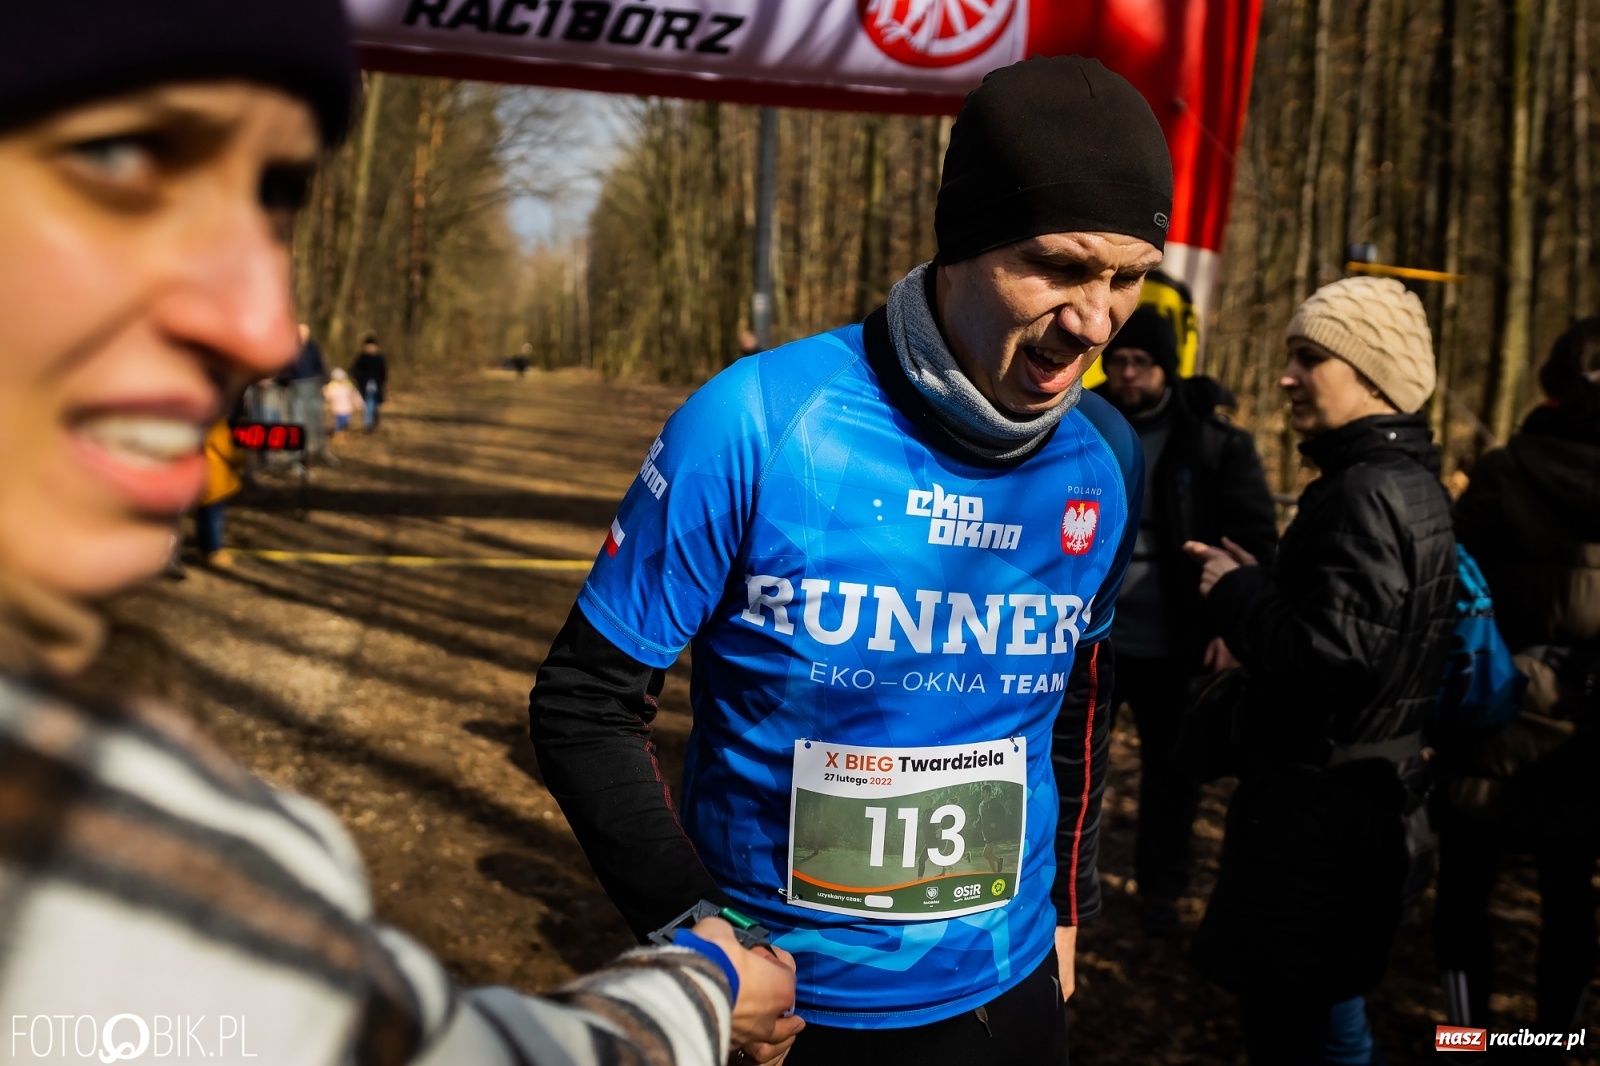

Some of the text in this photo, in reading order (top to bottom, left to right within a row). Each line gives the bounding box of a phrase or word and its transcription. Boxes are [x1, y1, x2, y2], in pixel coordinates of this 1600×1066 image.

[402, 0, 745, 54] RACIBÓRZ
[1067, 485, 1102, 496] POLAND
[999, 671, 1065, 694] TEAM
[825, 750, 1004, 773] X BIEG Twardziela
[824, 773, 892, 786] 27 lutego 2022
[865, 804, 967, 868] 113
[817, 892, 846, 902] uzyskany
